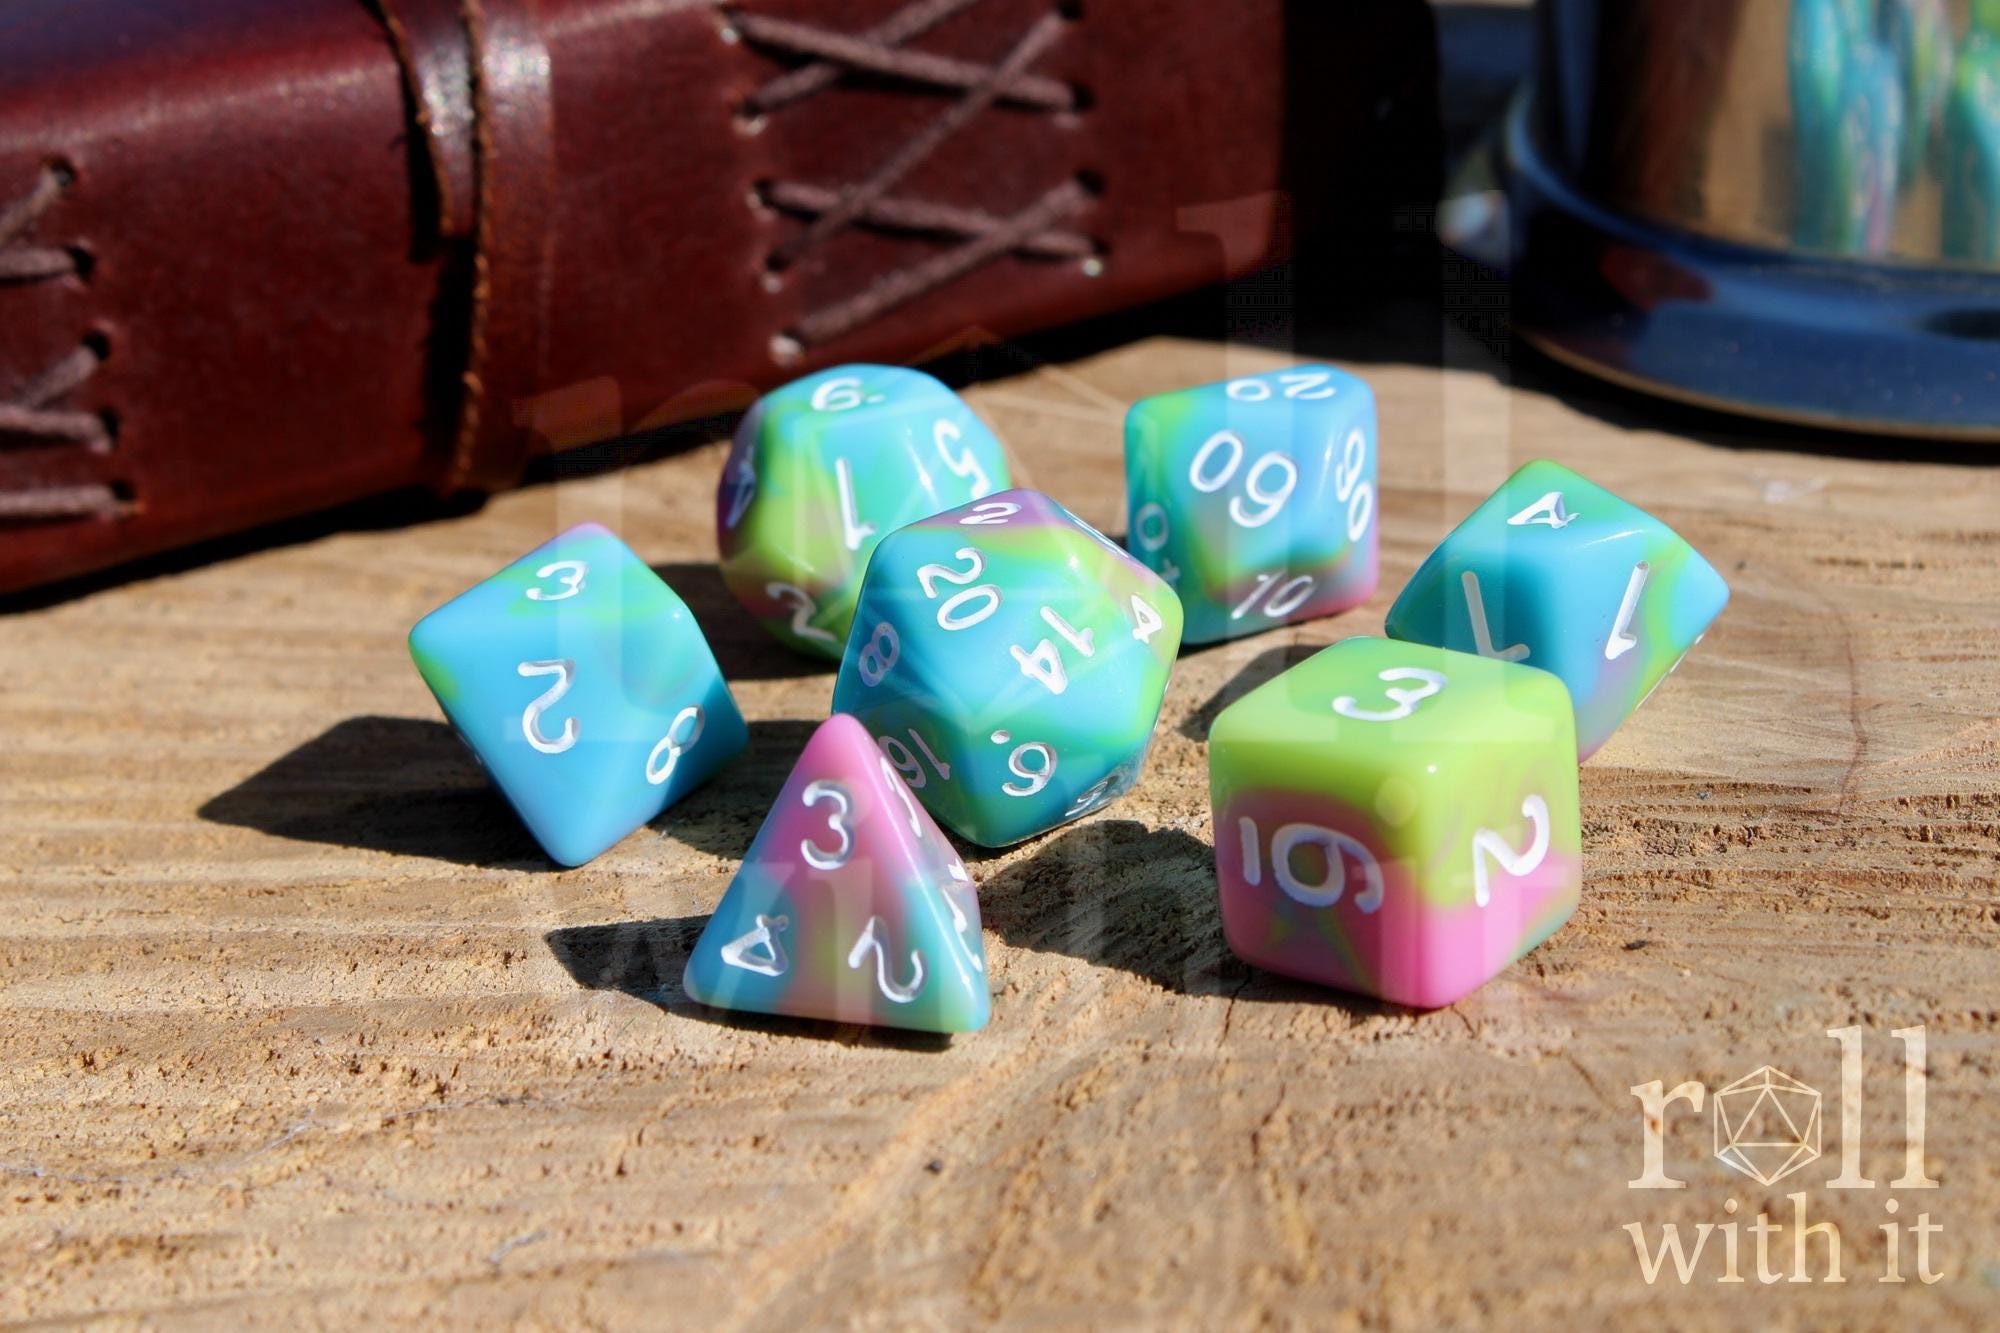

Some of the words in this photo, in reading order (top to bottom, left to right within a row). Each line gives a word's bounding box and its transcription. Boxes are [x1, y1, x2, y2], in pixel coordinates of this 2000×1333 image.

[834, 456, 876, 551] 1
[1506, 491, 1580, 529] 4
[524, 560, 588, 602] 3
[764, 581, 837, 641] 2
[915, 546, 1003, 632] 20
[1129, 593, 1164, 645] 4
[1230, 569, 1315, 621] 10
[1603, 559, 1650, 661] 1
[858, 621, 901, 688] 8
[1009, 605, 1096, 695] 14
[517, 658, 581, 755] 2
[1330, 666, 1448, 723] 3
[645, 704, 706, 786] 8
[800, 779, 855, 872] 3
[1472, 793, 1551, 908] 2
[720, 913, 790, 978] 4
[847, 914, 928, 1005] 2
